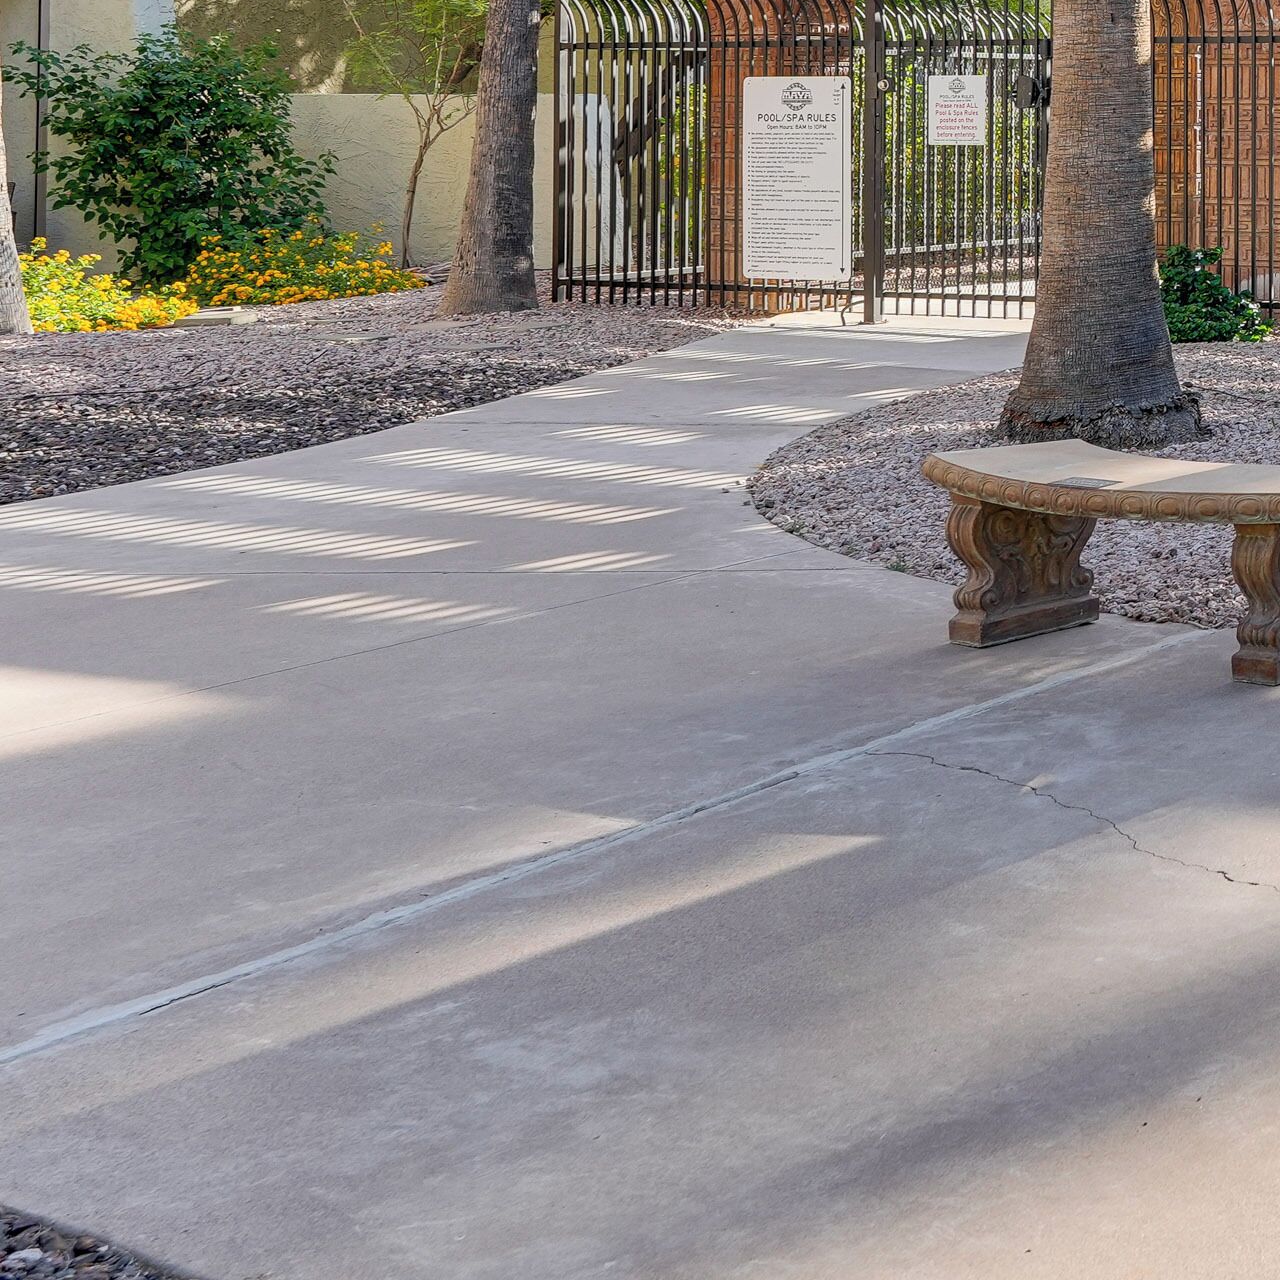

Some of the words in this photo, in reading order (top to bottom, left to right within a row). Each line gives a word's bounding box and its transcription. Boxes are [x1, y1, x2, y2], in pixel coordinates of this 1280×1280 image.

[782, 91, 811, 99] MAYA
[757, 113, 805, 122] POOL/SPA
[806, 113, 837, 122] RULES
